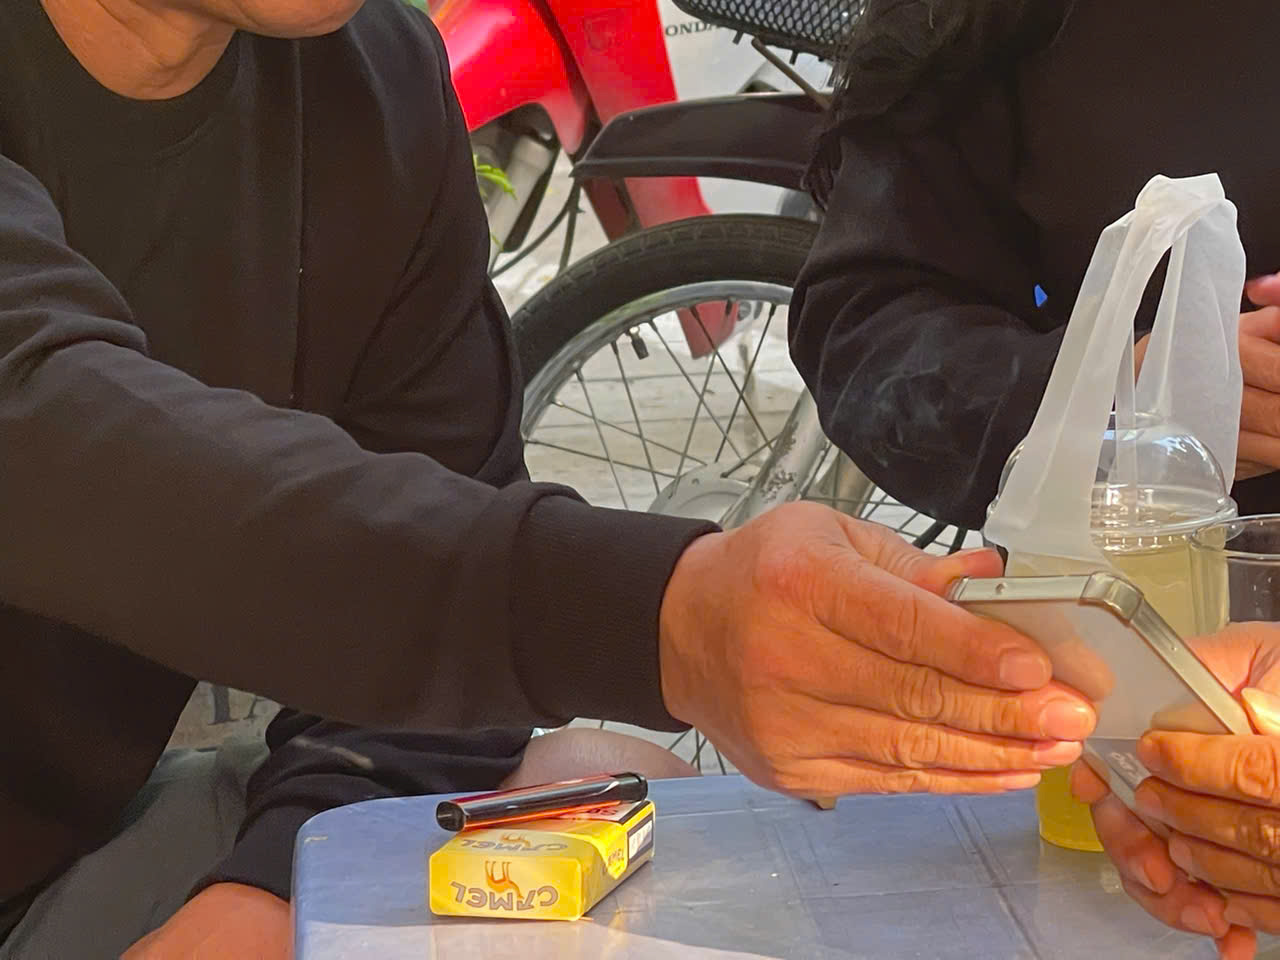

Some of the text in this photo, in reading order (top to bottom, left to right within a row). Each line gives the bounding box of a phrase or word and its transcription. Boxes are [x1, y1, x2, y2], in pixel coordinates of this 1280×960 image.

[665, 21, 719, 37] OND
[461, 839, 569, 853] CAMEL
[449, 880, 559, 912] CAMEL
